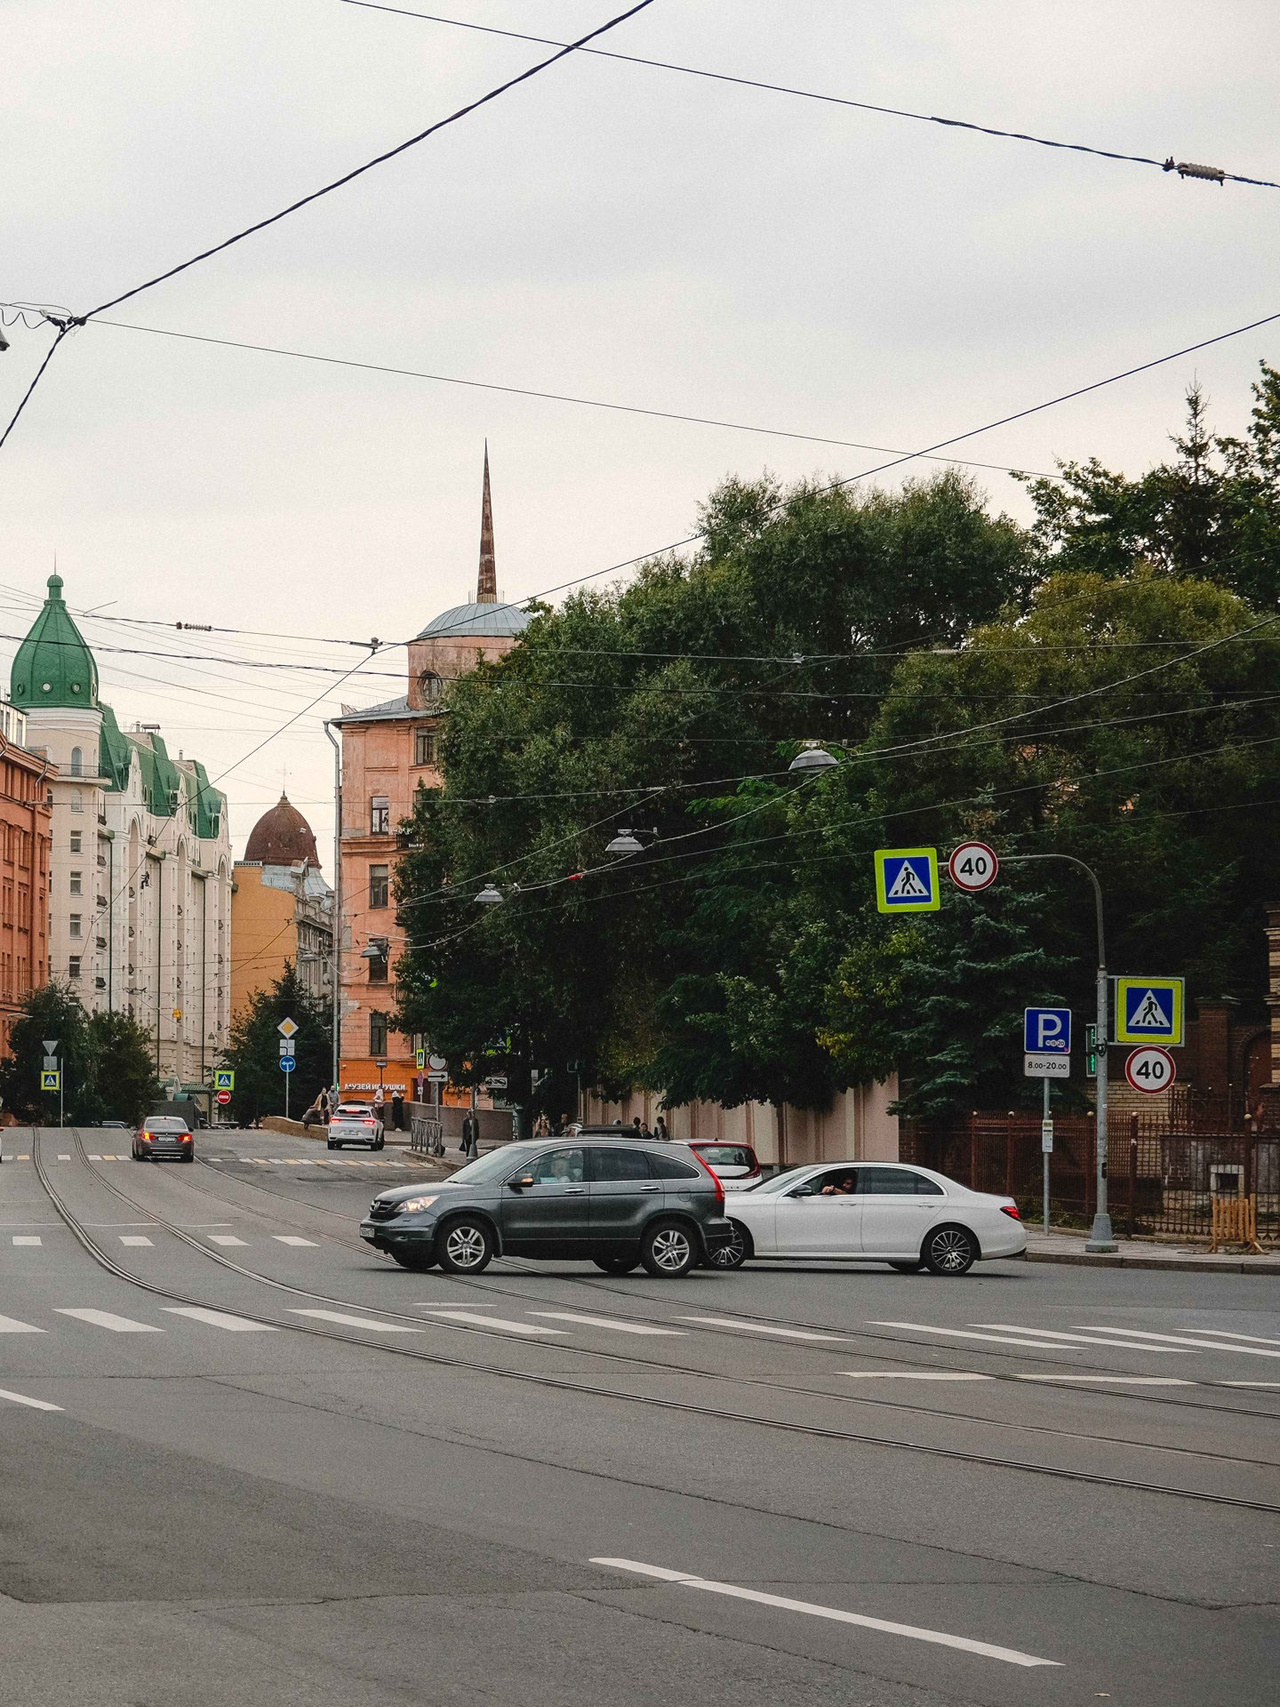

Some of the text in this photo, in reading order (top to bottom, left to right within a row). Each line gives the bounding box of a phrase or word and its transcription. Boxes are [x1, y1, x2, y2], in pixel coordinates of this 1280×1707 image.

[960, 857, 987, 876] 40
[1038, 1014, 1062, 1048] P
[1028, 1061, 1067, 1070] 8.00-20.00
[1136, 1061, 1164, 1079] 40
